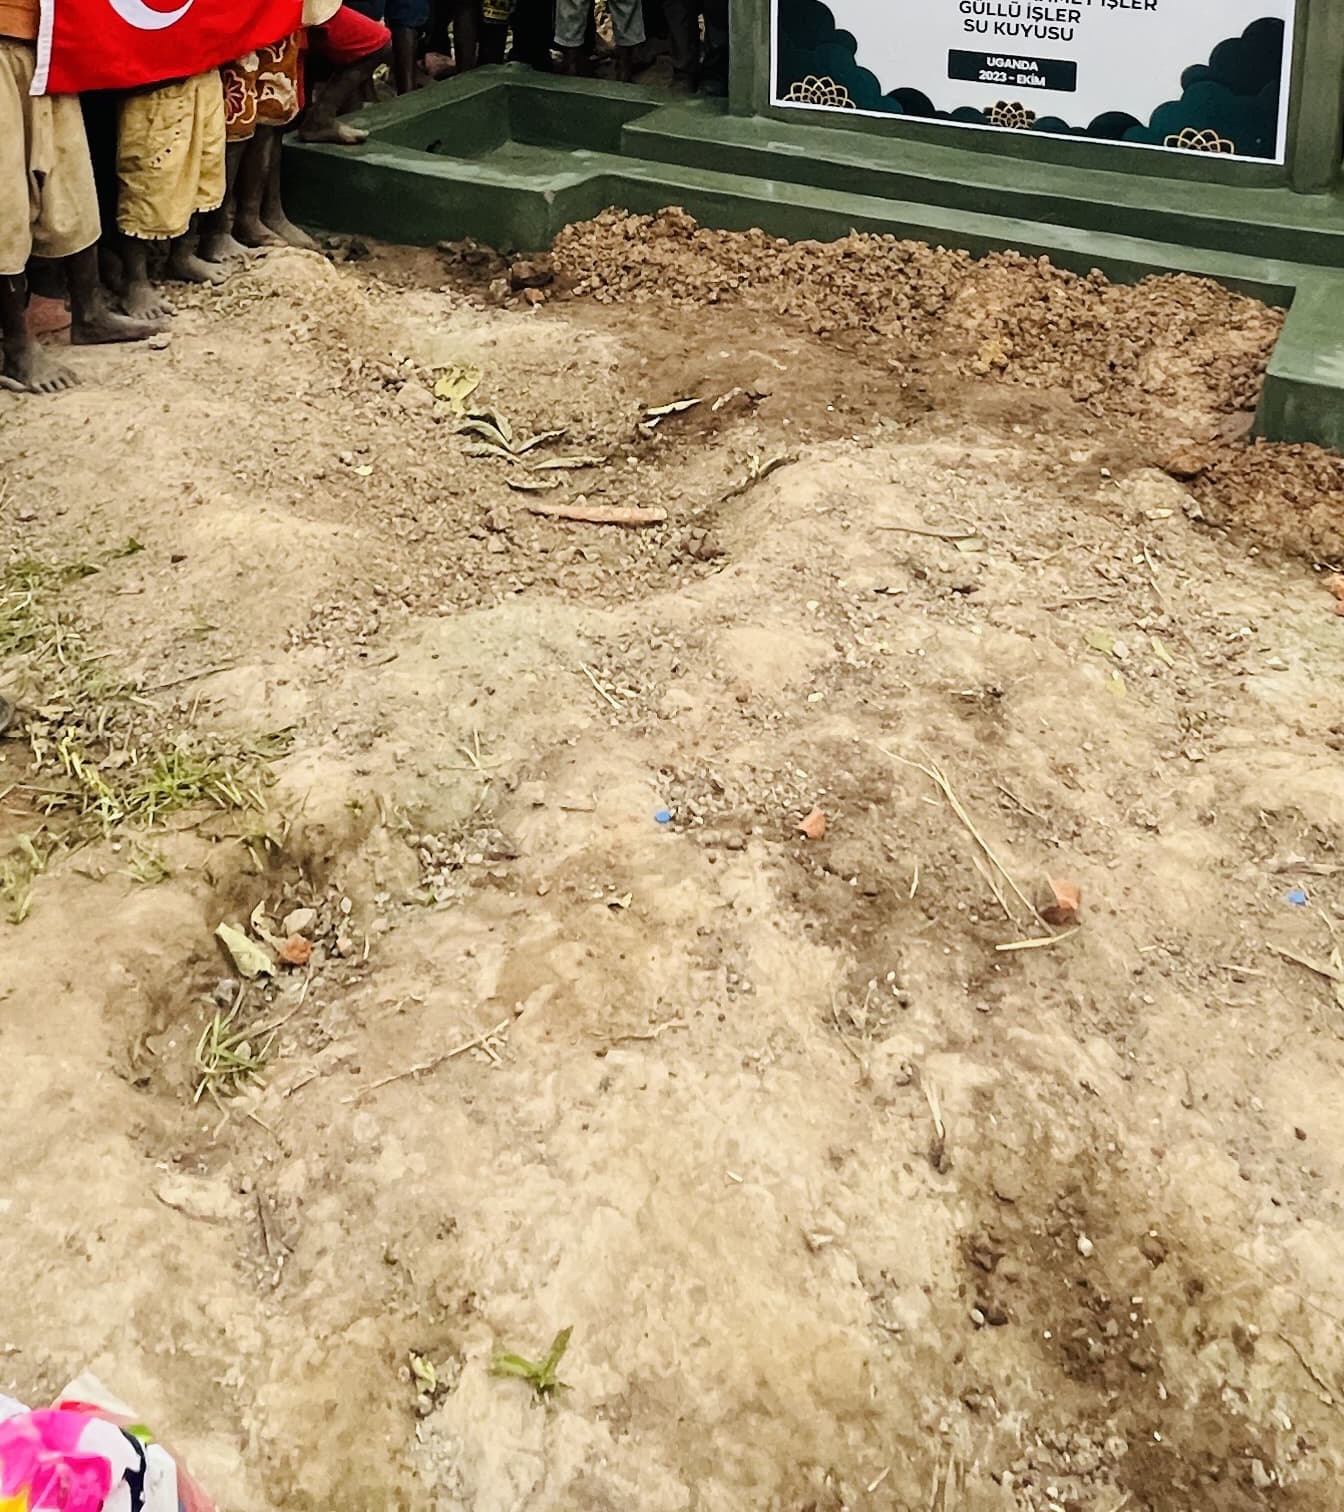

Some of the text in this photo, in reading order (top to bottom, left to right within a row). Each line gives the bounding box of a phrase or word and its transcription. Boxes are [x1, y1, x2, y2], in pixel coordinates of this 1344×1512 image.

[1026, 2, 1081, 24] İŞLER
[963, 18, 1074, 41] SU KUYUSU
[986, 56, 1039, 72] UGANDA
[978, 69, 1007, 83] 2023
[1016, 73, 1046, 87] EKİM
